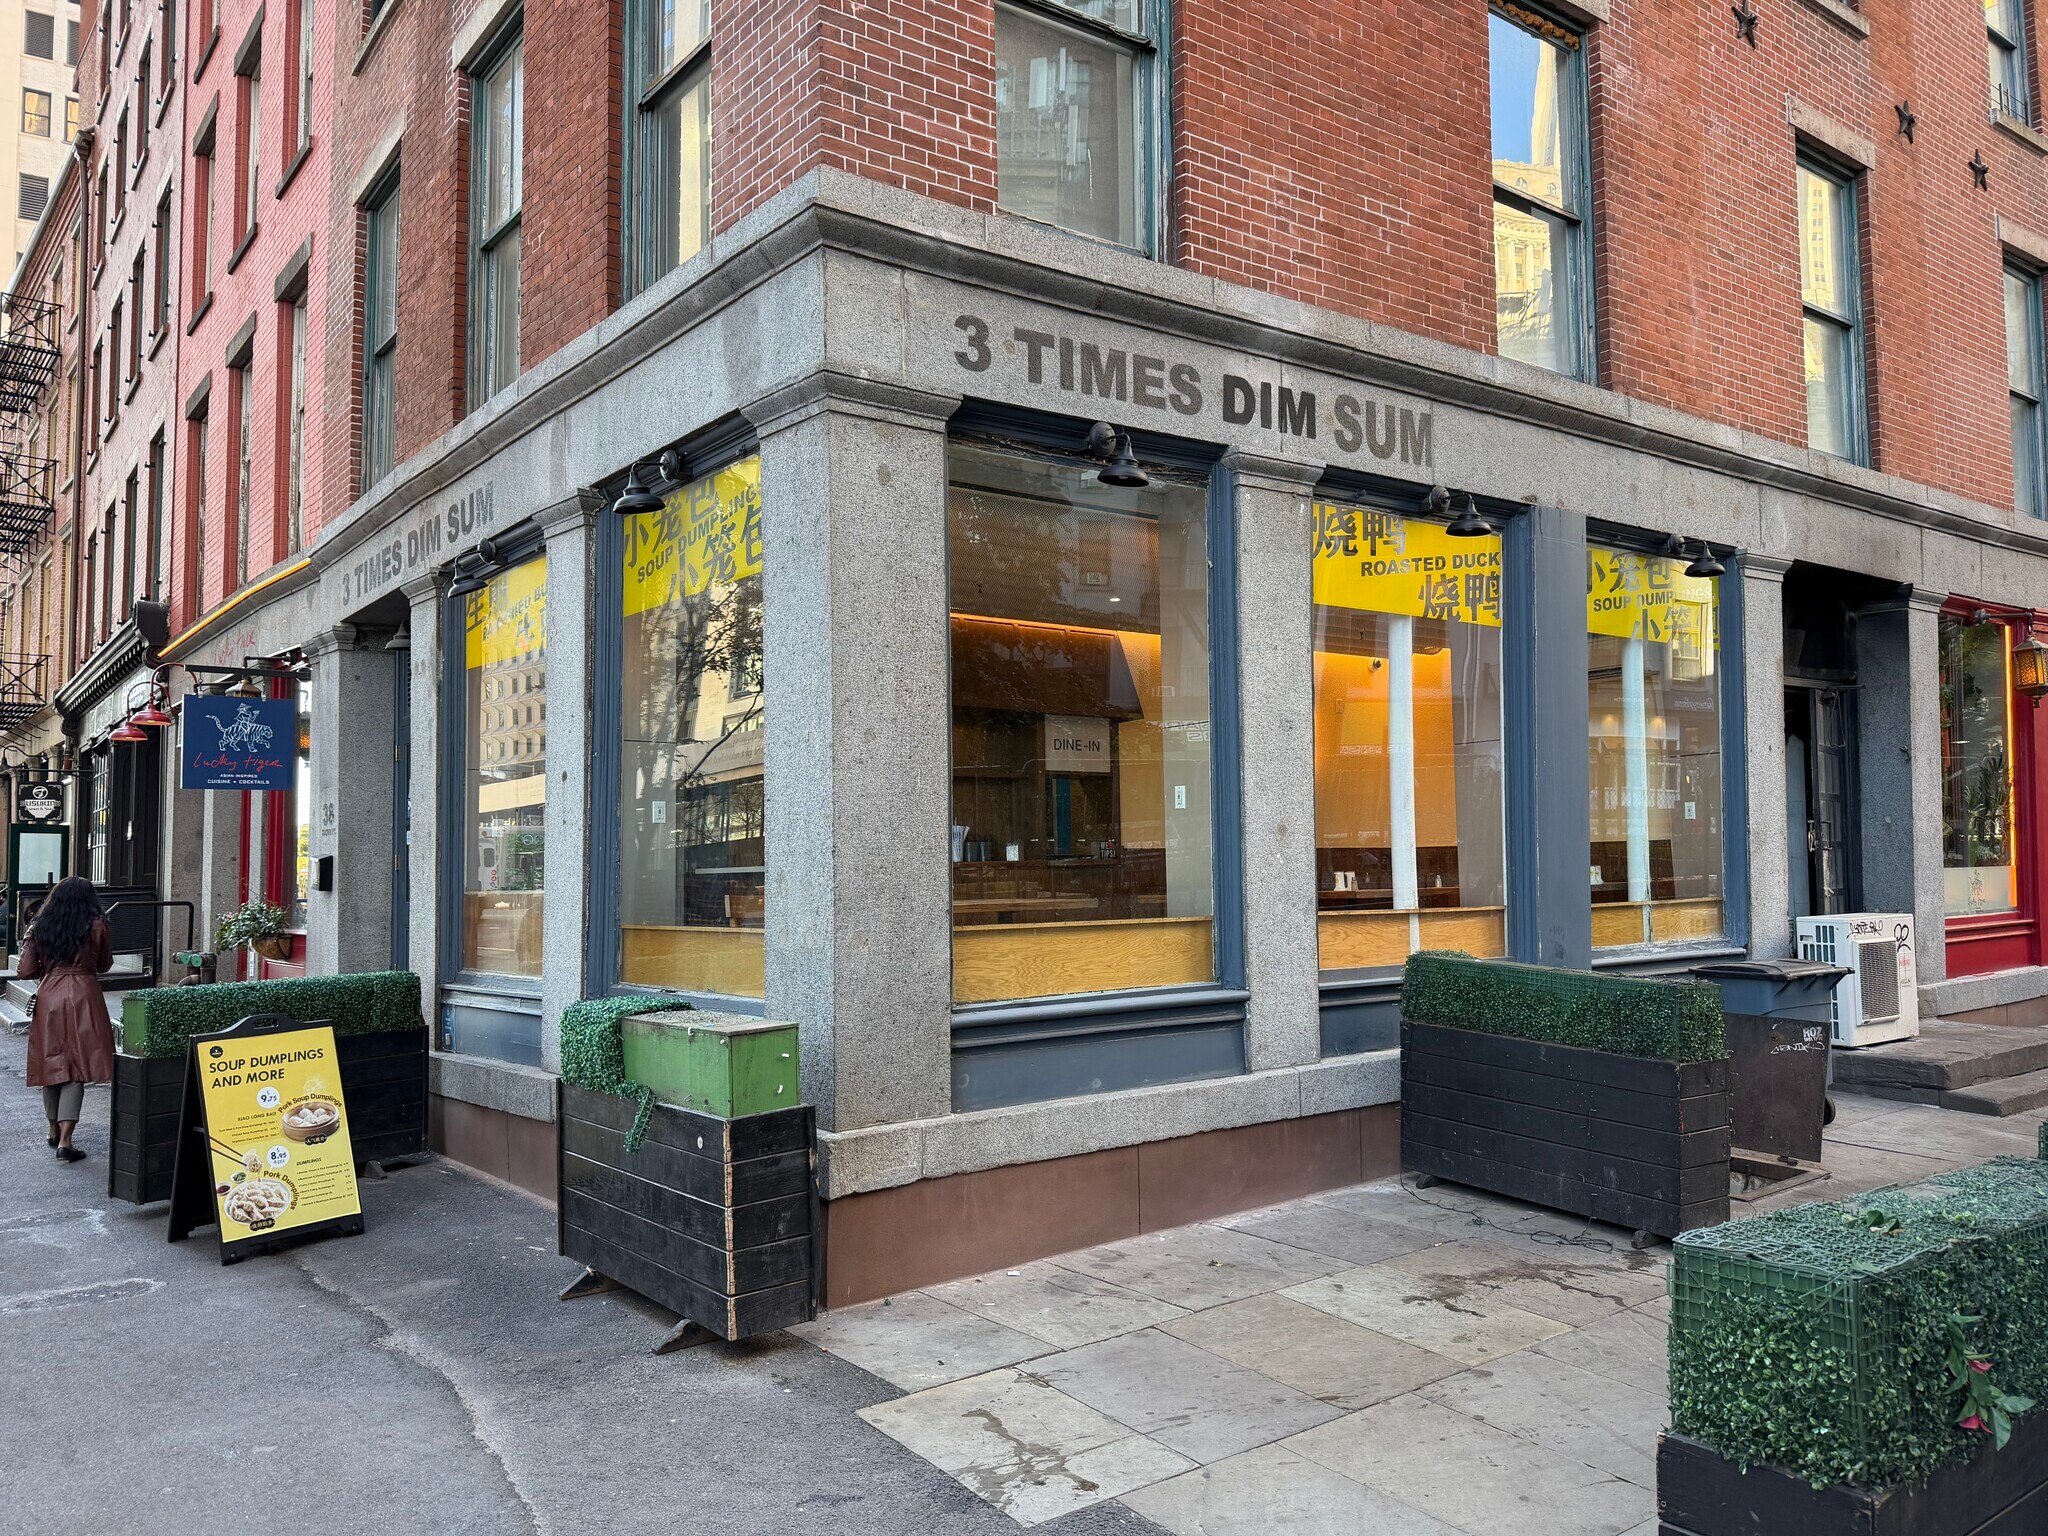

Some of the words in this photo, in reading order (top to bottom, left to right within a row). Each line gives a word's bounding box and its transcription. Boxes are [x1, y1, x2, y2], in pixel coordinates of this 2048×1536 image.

[954, 314, 992, 372] 3
[1014, 327, 1202, 416] TIMES
[1222, 374, 1317, 440] DIM
[1333, 393, 1433, 468] SUM
[342, 573, 350, 606] 3
[354, 539, 402, 598] TIMES
[407, 513, 441, 568] DIM
[447, 481, 494, 544] SUM
[637, 544, 673, 584] SOUP
[1361, 555, 1447, 577] ROASTED
[1452, 551, 1501, 570] DUCK
[1593, 596, 1632, 612] SOUP
[1053, 738, 1100, 752] DINE-IN
[209, 1059, 246, 1074] SOUP
[250, 1048, 324, 1068] DUMPLINGS
[212, 1075, 242, 1089] AND
[246, 1068, 285, 1084] MORE
[278, 1100, 292, 1113] Pork
[292, 1094, 310, 1105] Soup
[310, 1093, 343, 1108] Dumplings
[296, 1157, 322, 1166] DUMPLINGS
[282, 1174, 300, 1210] Dumplings
